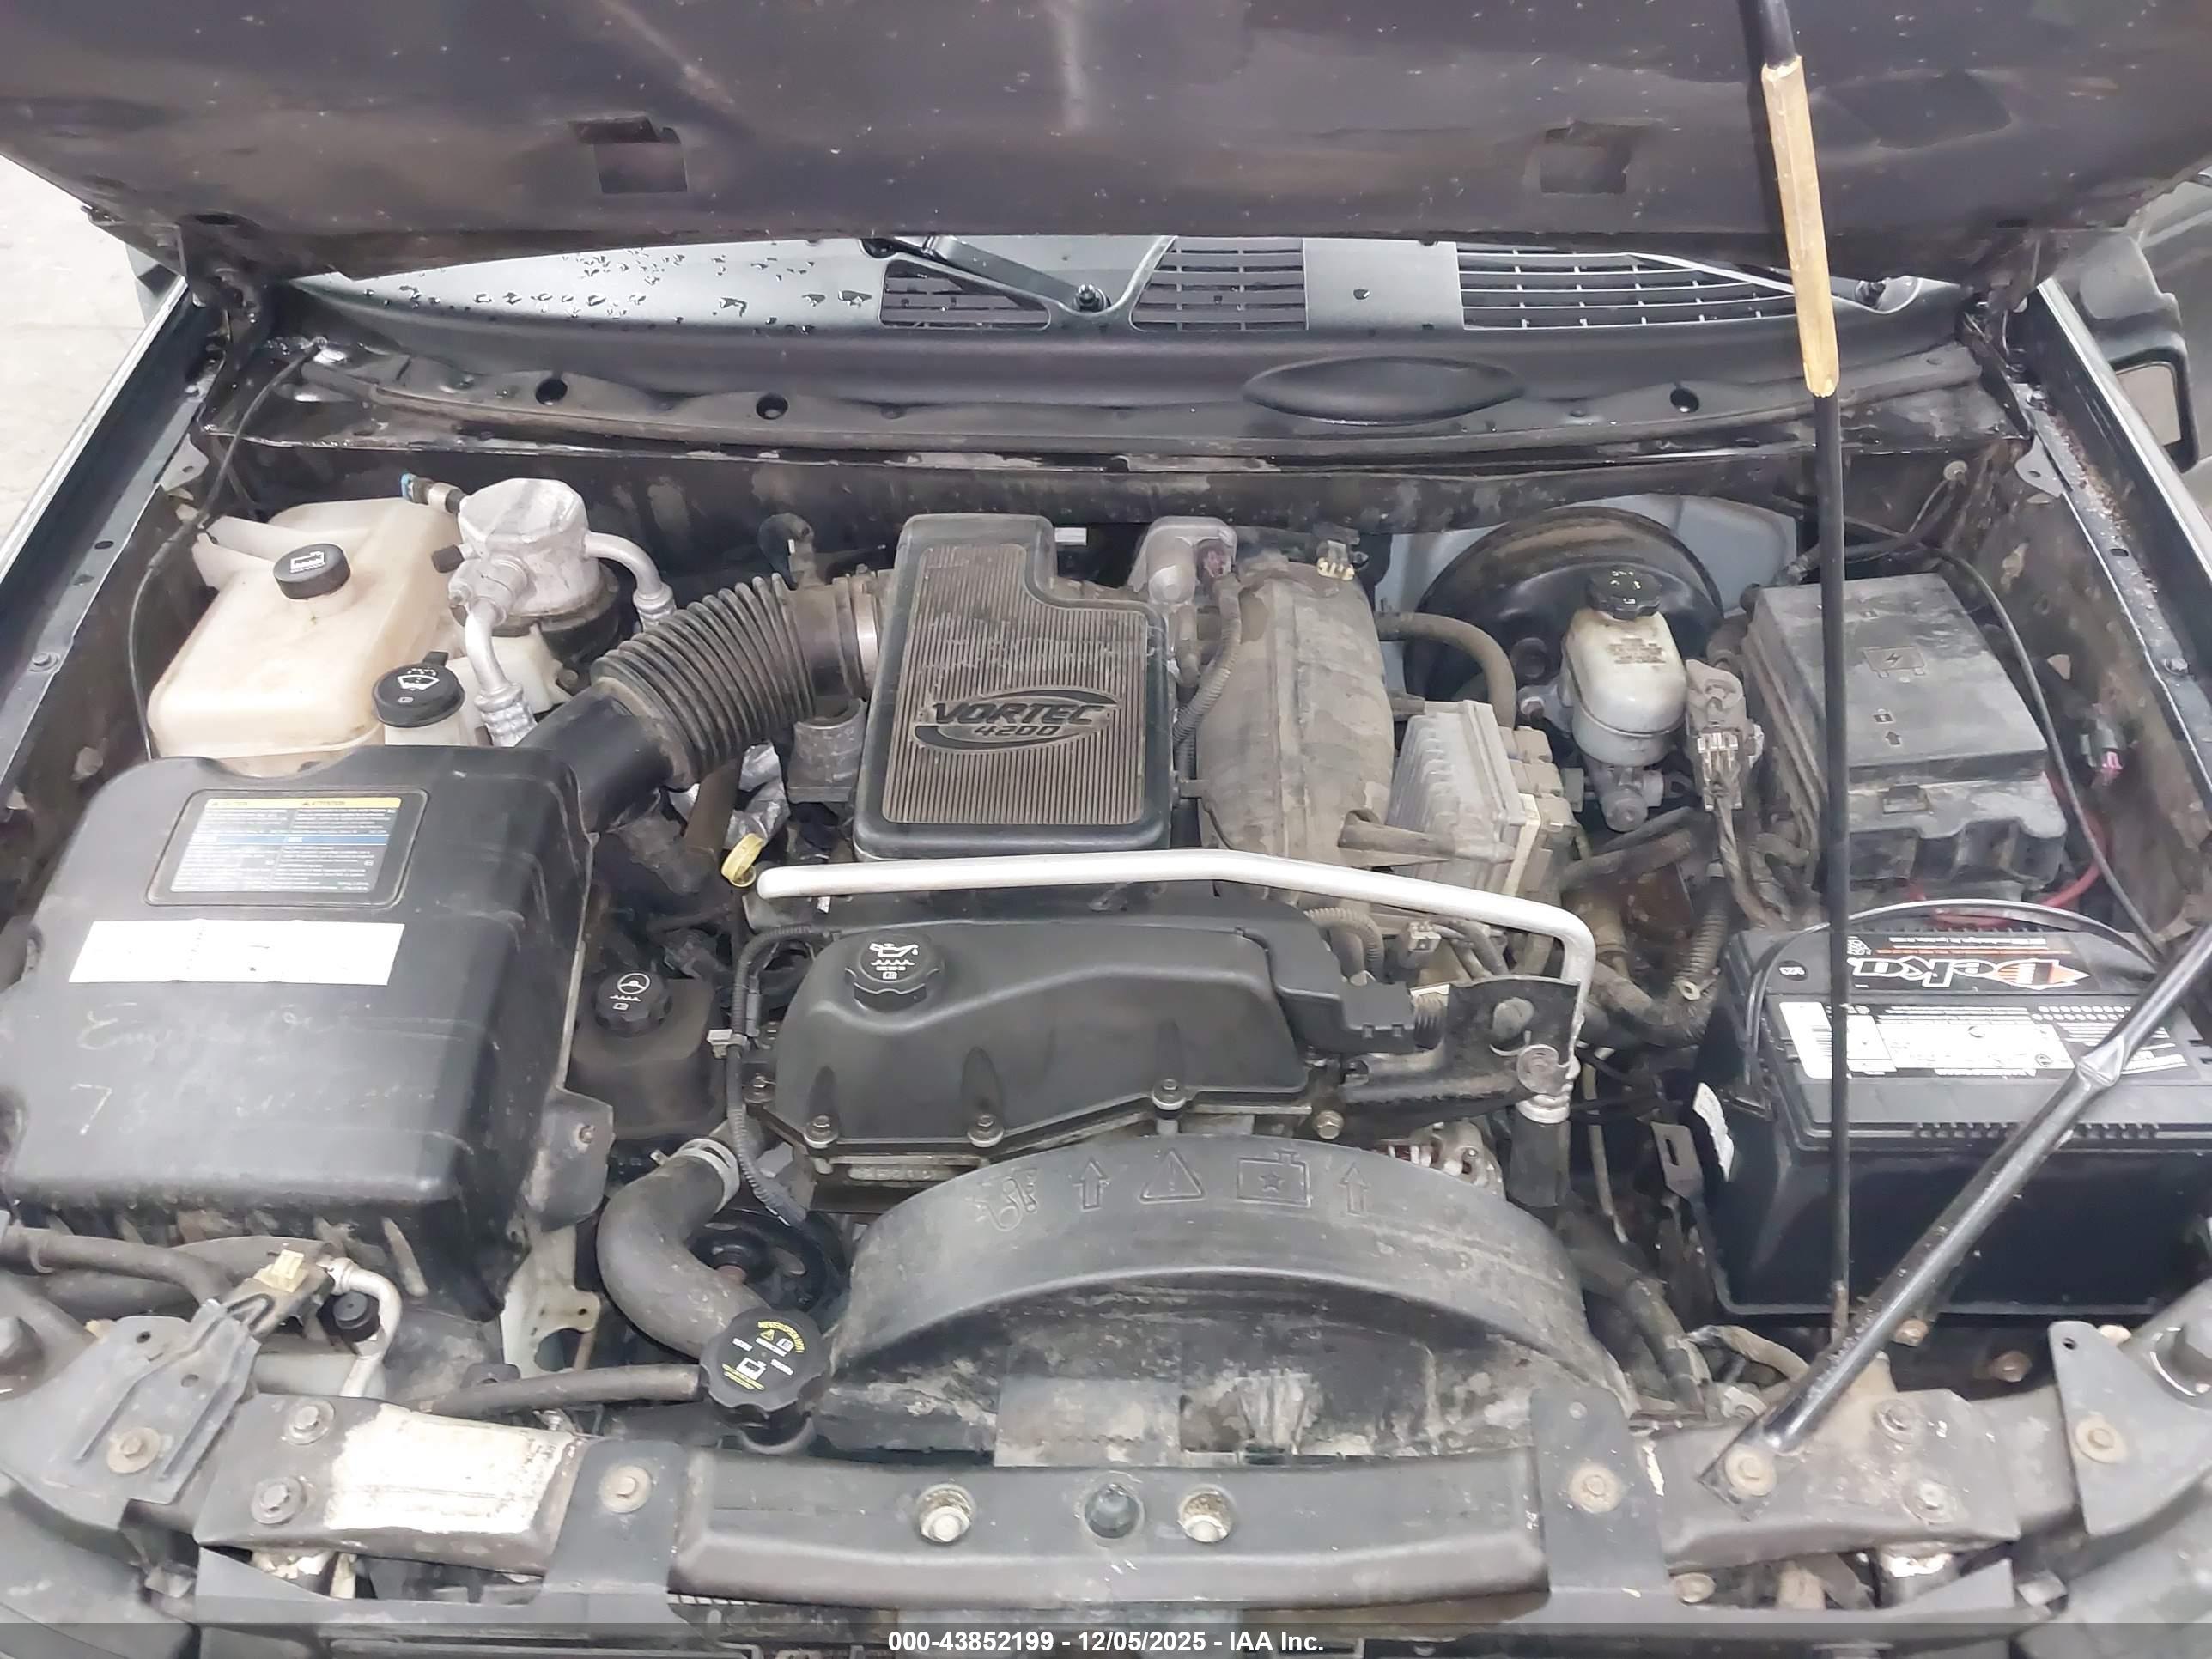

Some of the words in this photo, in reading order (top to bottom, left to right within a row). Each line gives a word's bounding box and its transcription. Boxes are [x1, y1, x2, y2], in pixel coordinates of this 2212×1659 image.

[933, 702, 1106, 725] VORTEC
[974, 725, 1062, 737] 4200
[1845, 955, 2091, 991] Deka
